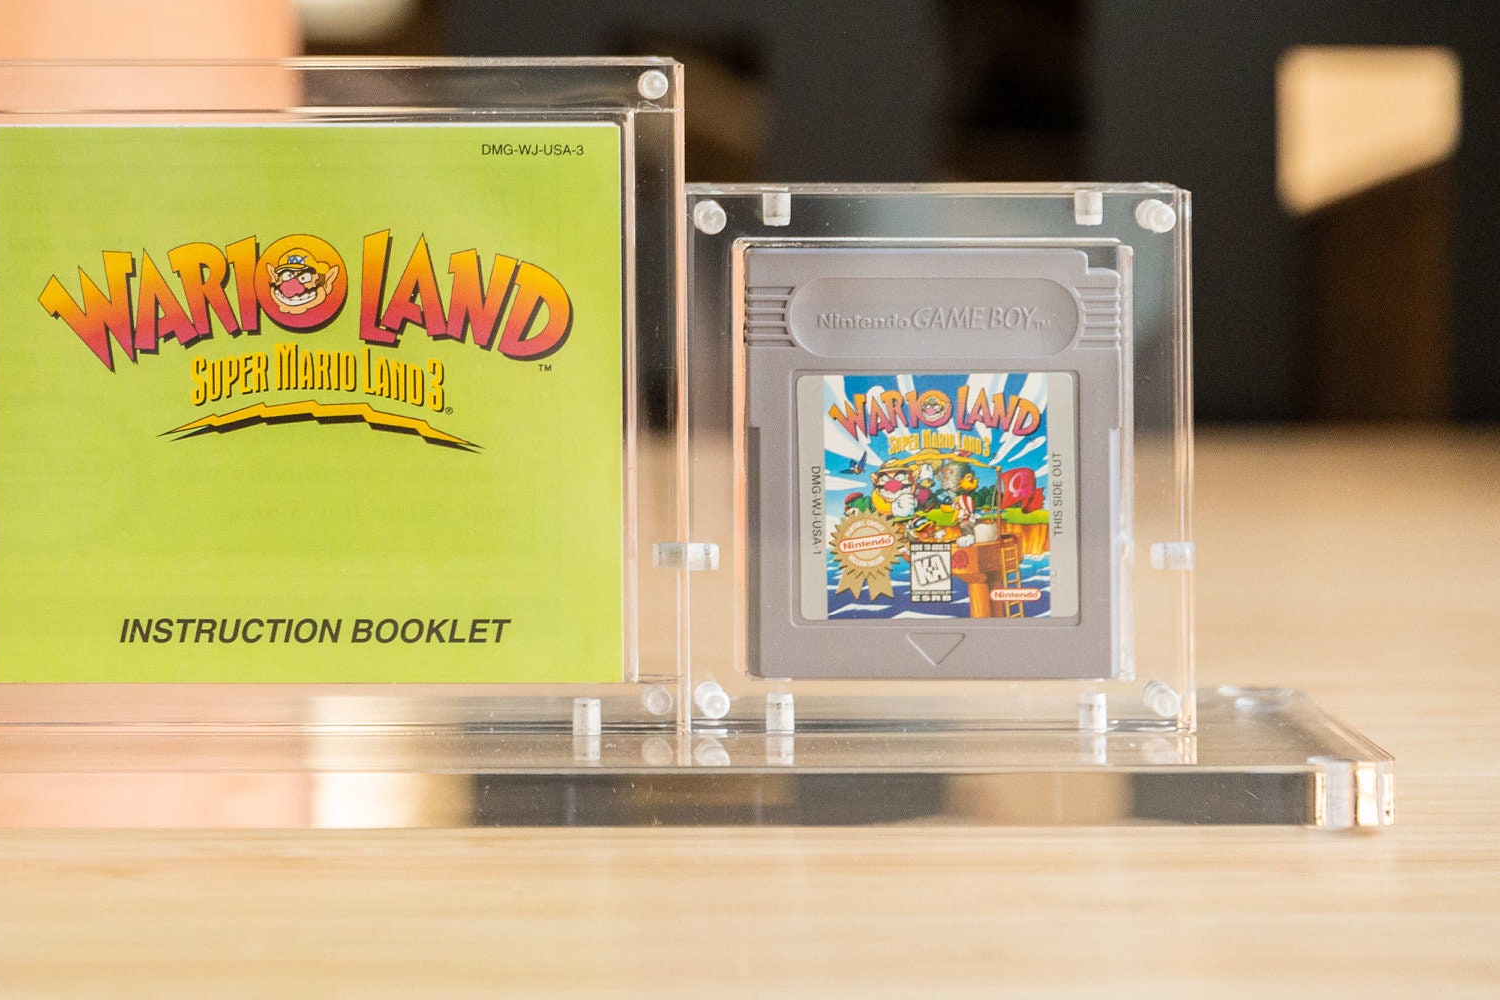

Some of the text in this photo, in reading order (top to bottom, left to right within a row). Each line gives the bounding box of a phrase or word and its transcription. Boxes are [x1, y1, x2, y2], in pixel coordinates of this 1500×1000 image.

[481, 144, 584, 156] DMG-WJ-USA-3
[38, 233, 350, 374] WARIO
[359, 228, 574, 362] LAND
[817, 312, 911, 330] Nintendo
[912, 305, 987, 330] GAME
[989, 305, 1038, 330] BOY
[190, 342, 445, 412] SUPER MARIO LAND 3
[828, 385, 1041, 442] WARIO LAND
[888, 430, 992, 457] SUPER MARIO LAND 3
[1052, 453, 1064, 536] THIS SIDE OUT
[843, 537, 891, 550] Nintendo
[119, 618, 511, 643] INSTRUCTION BOOKLET
